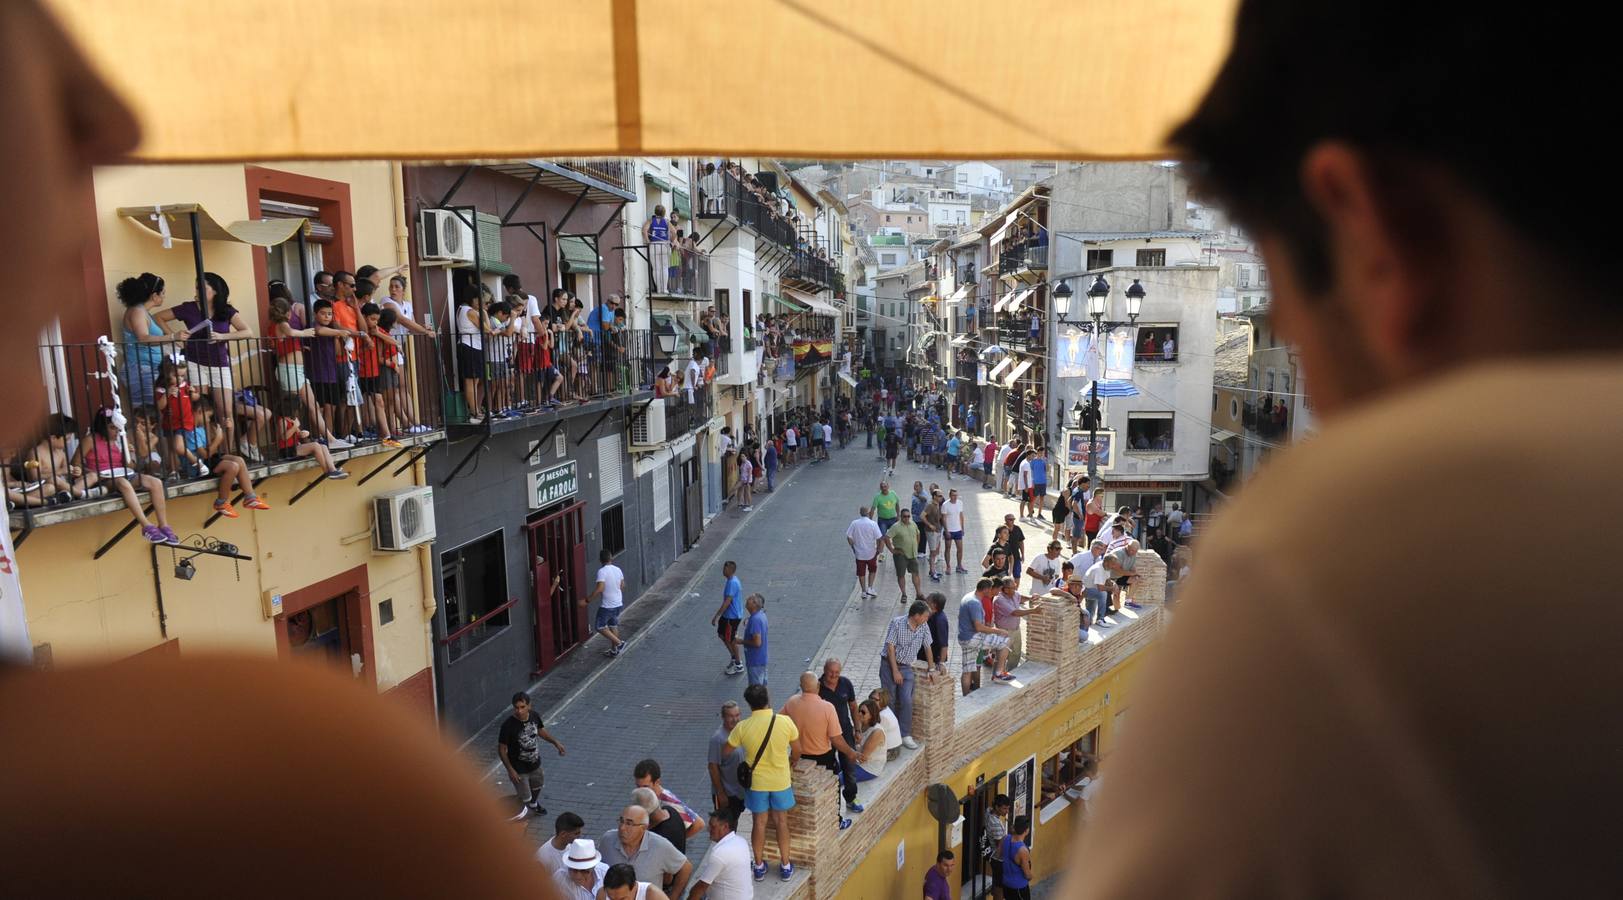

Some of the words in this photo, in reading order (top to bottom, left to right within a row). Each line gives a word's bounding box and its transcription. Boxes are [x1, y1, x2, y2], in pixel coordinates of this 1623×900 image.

[546, 467, 569, 481] MESÓN
[538, 489, 548, 504] LA
[549, 477, 576, 500] FAROLA
